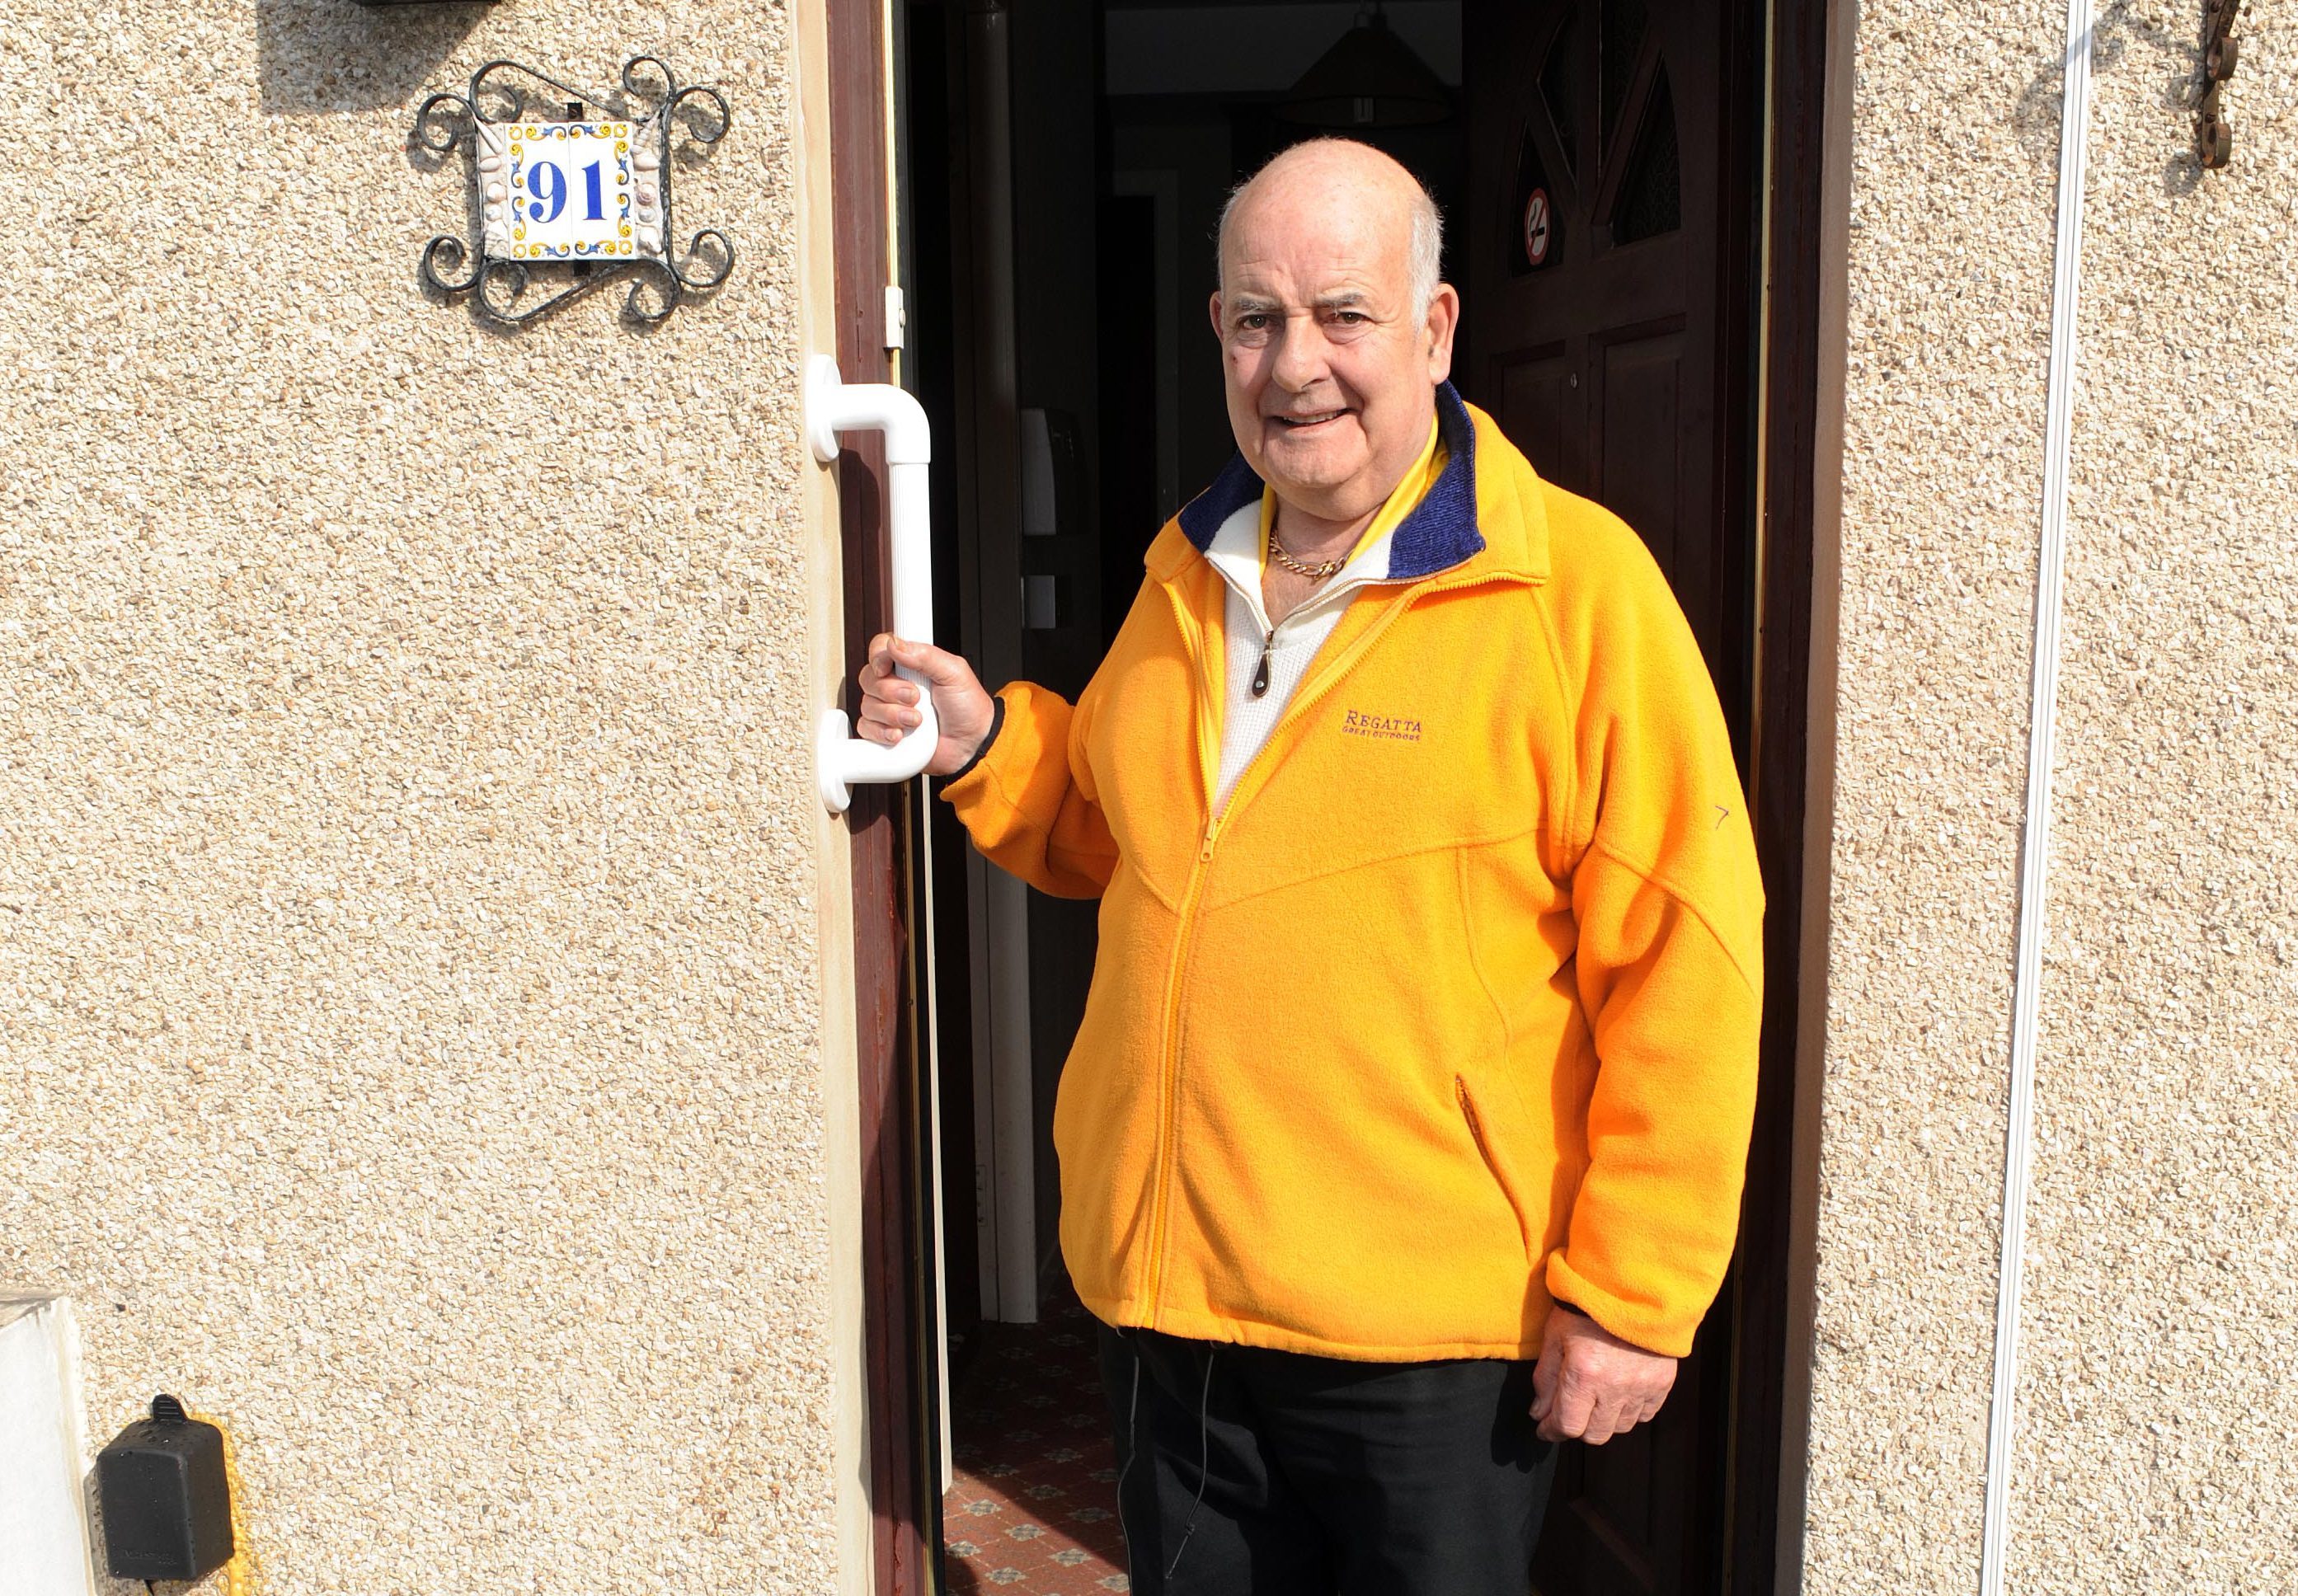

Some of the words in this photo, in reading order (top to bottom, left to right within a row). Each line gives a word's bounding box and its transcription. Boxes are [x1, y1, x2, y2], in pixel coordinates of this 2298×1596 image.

[526, 159, 608, 223] 91
[1342, 725, 1370, 736] GREAT
[1346, 709, 1422, 732] REGATTA
